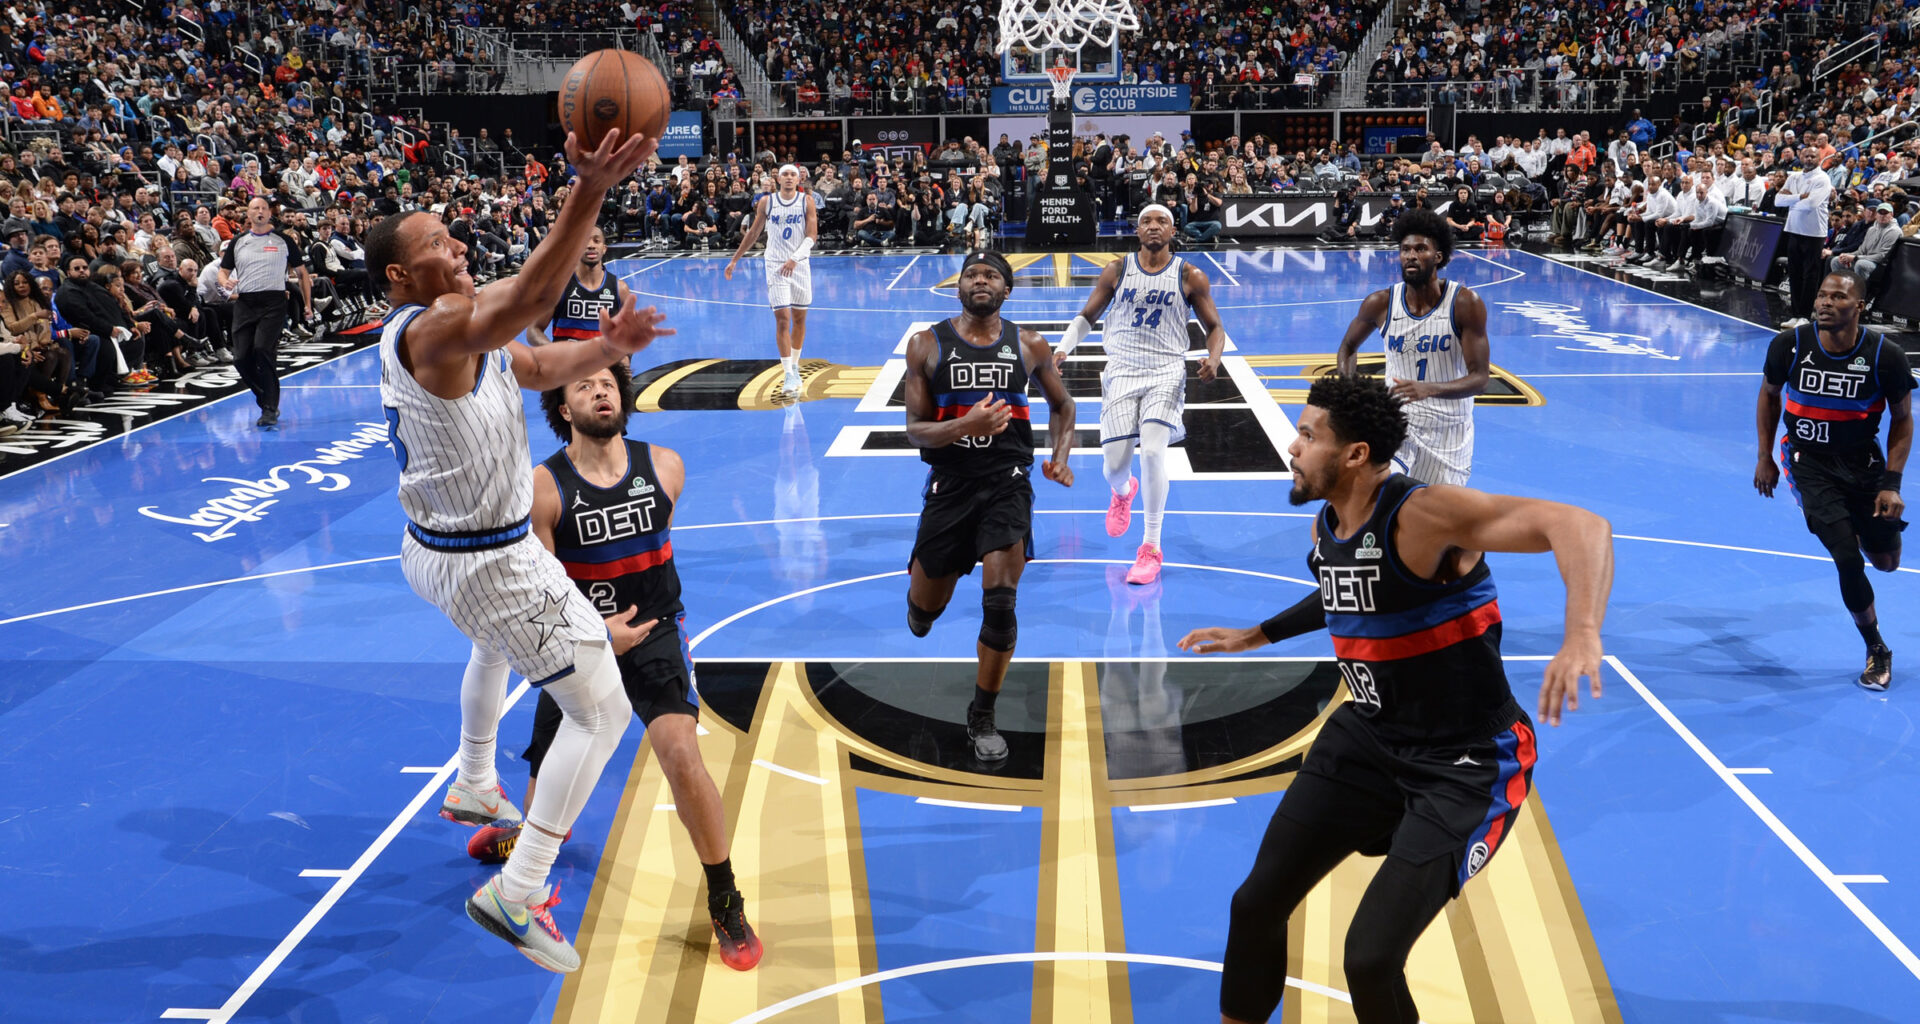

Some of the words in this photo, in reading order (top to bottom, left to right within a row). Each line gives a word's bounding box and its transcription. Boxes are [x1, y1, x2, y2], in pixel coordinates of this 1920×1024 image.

[1100, 86, 1177, 98] COURTSIDE
[1100, 99, 1136, 110] CLUB
[664, 126, 690, 135] URE
[1041, 198, 1075, 206] HENRY
[1042, 216, 1081, 224] HEALTH
[783, 227, 792, 240] 0
[567, 299, 613, 319] DET
[1131, 308, 1162, 328] 34
[950, 363, 1013, 389] DET
[1416, 359, 1428, 381] 1
[1799, 368, 1866, 398] DET
[1796, 419, 1829, 442] 31
[575, 496, 656, 545] DET
[1356, 549, 1382, 559] StockX
[589, 582, 618, 614] 2
[1319, 566, 1380, 612] DET
[1338, 662, 1381, 708] 12
